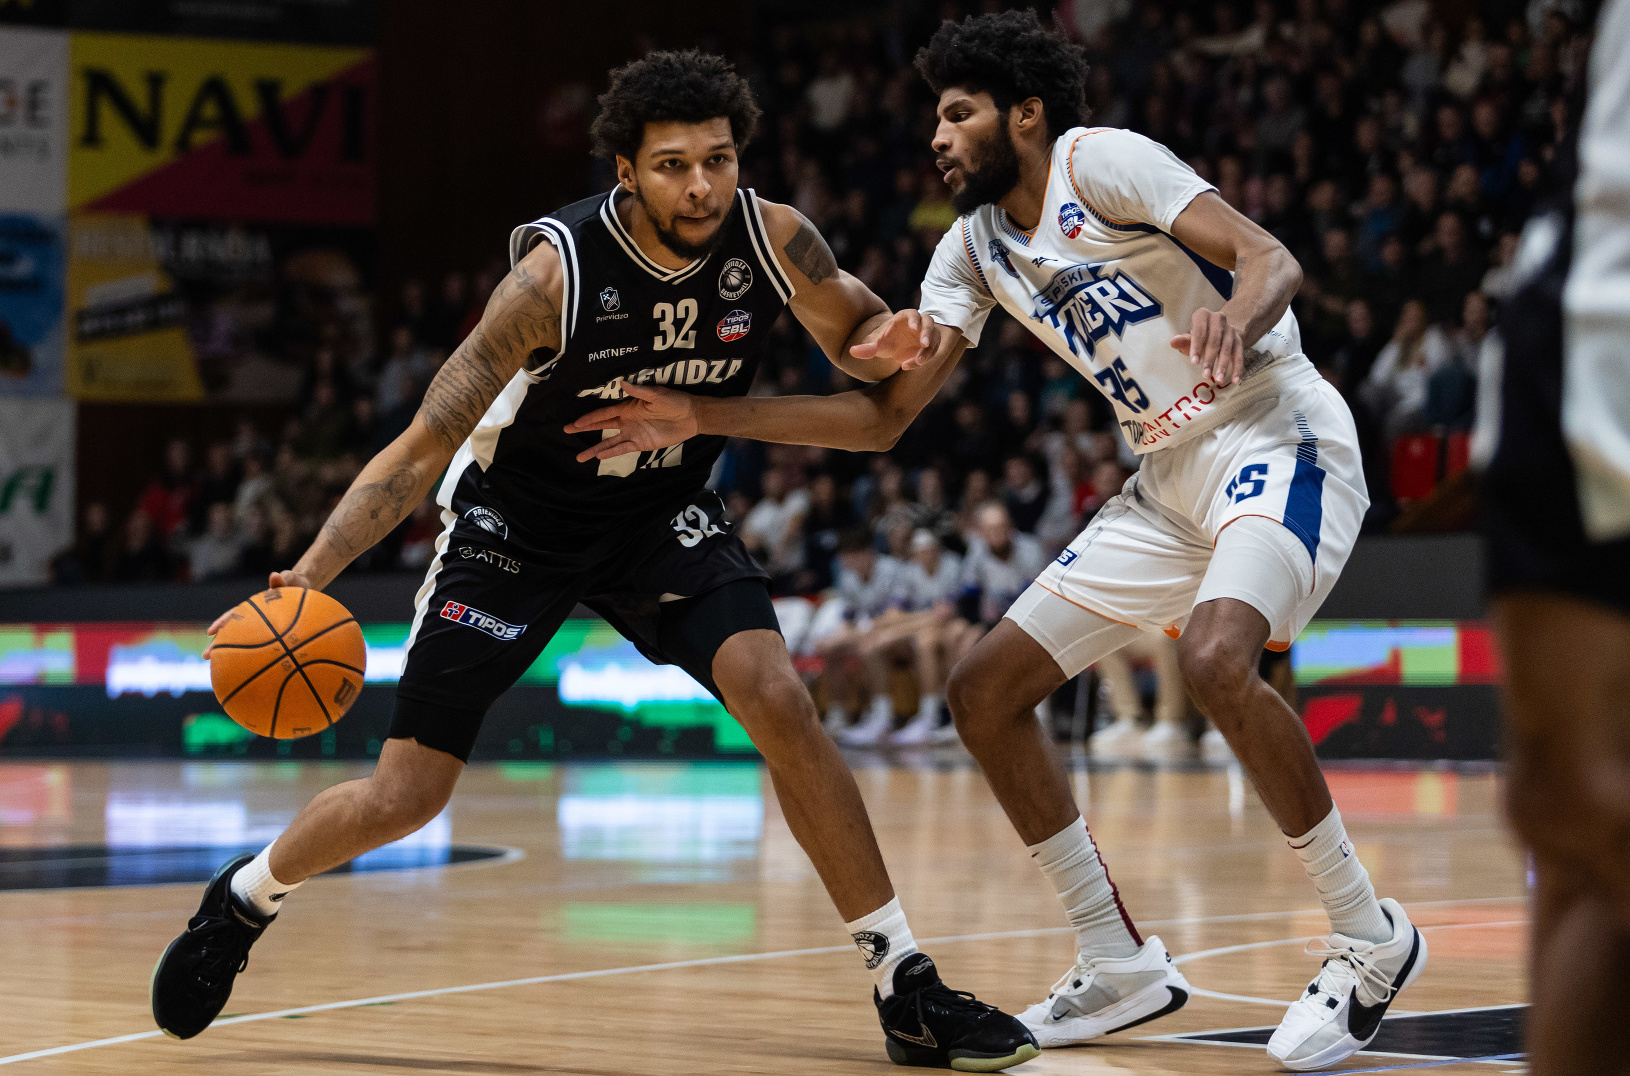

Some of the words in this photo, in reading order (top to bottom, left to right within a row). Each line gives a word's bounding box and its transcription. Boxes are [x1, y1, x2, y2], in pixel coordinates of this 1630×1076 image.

[81, 67, 366, 161] NAVI
[1061, 216, 1084, 236] SBL
[596, 313, 629, 324] Prievidza
[653, 298, 698, 351] 32
[720, 322, 748, 338] SBL
[726, 313, 750, 324] TIPOS
[588, 346, 639, 363] PARTNERS
[576, 358, 744, 400] REVIDZA
[669, 504, 727, 548] 32
[476, 549, 522, 574] ATTIS
[469, 610, 521, 638] TIPOS
